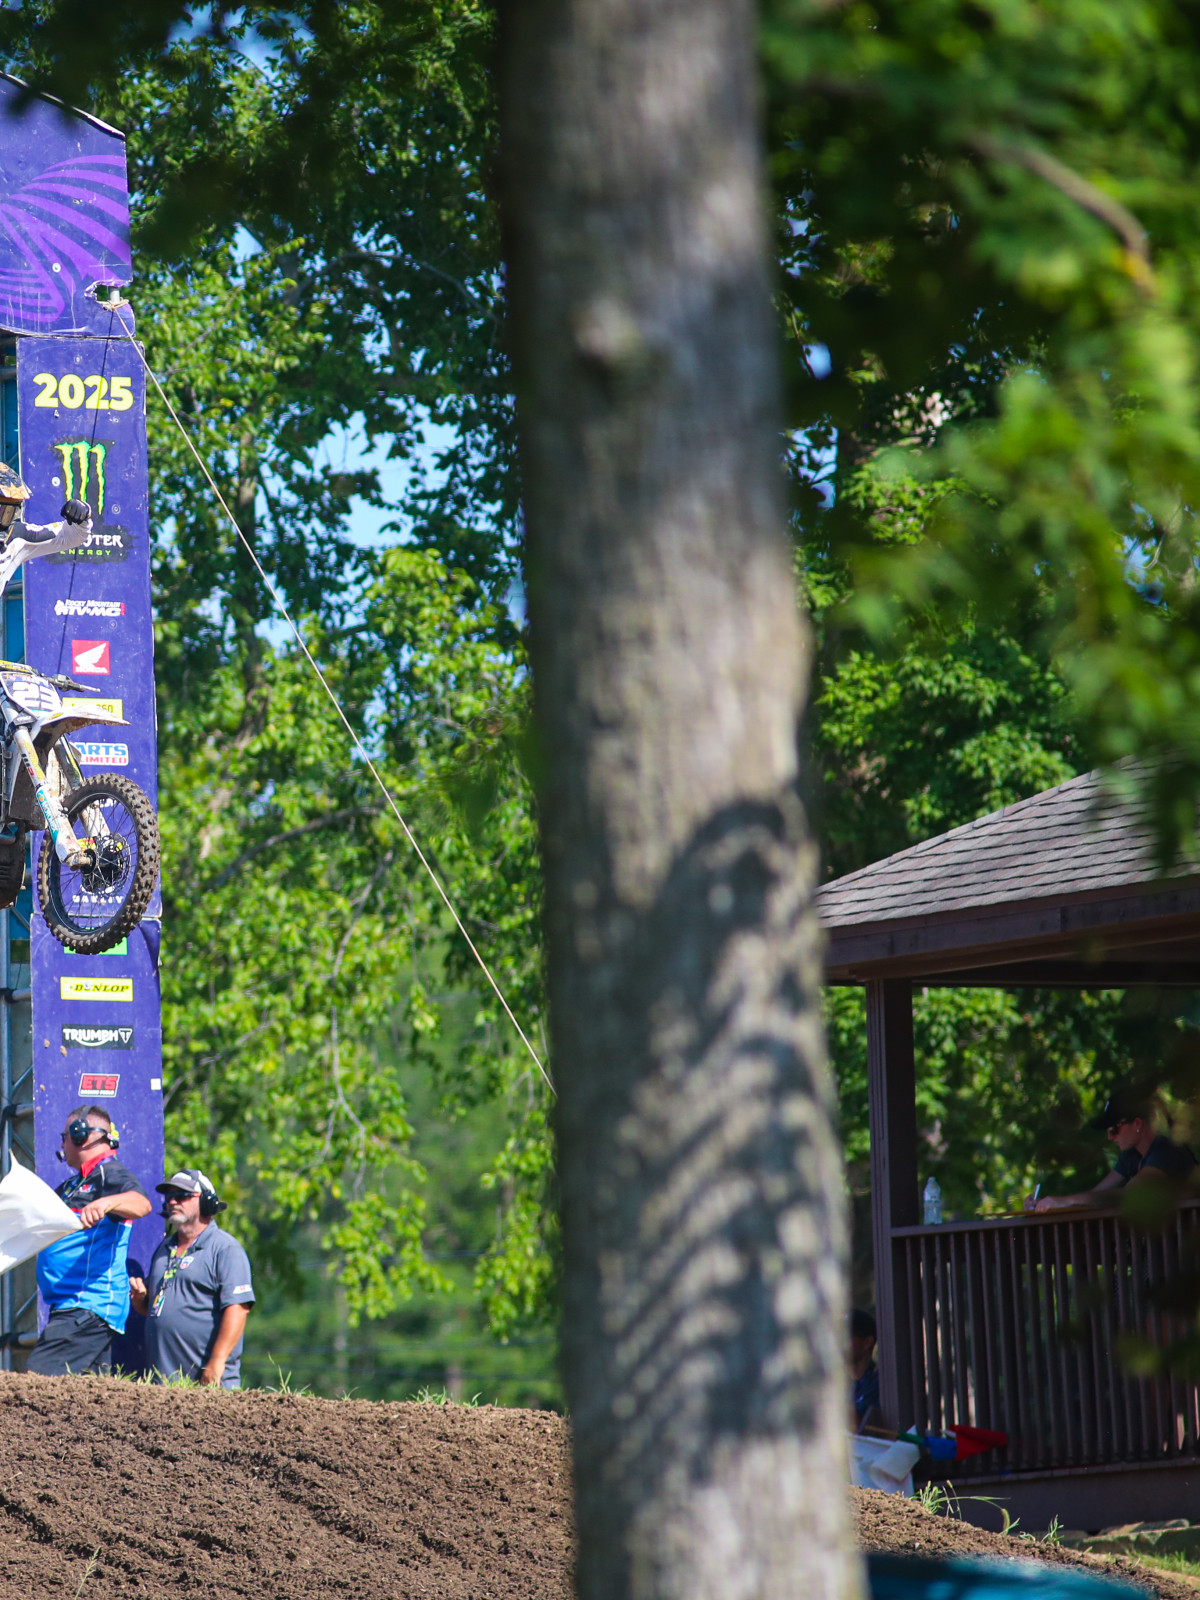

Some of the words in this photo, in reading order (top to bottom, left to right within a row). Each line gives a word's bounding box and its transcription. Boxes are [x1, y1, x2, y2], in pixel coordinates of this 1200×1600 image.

[32, 373, 134, 411] 2025
[75, 744, 127, 756] ARTS
[79, 756, 127, 764] LIMITED
[74, 983, 129, 992] DUNLOP
[62, 1028, 119, 1046] TRIUMPH
[81, 1075, 118, 1090] ETS
